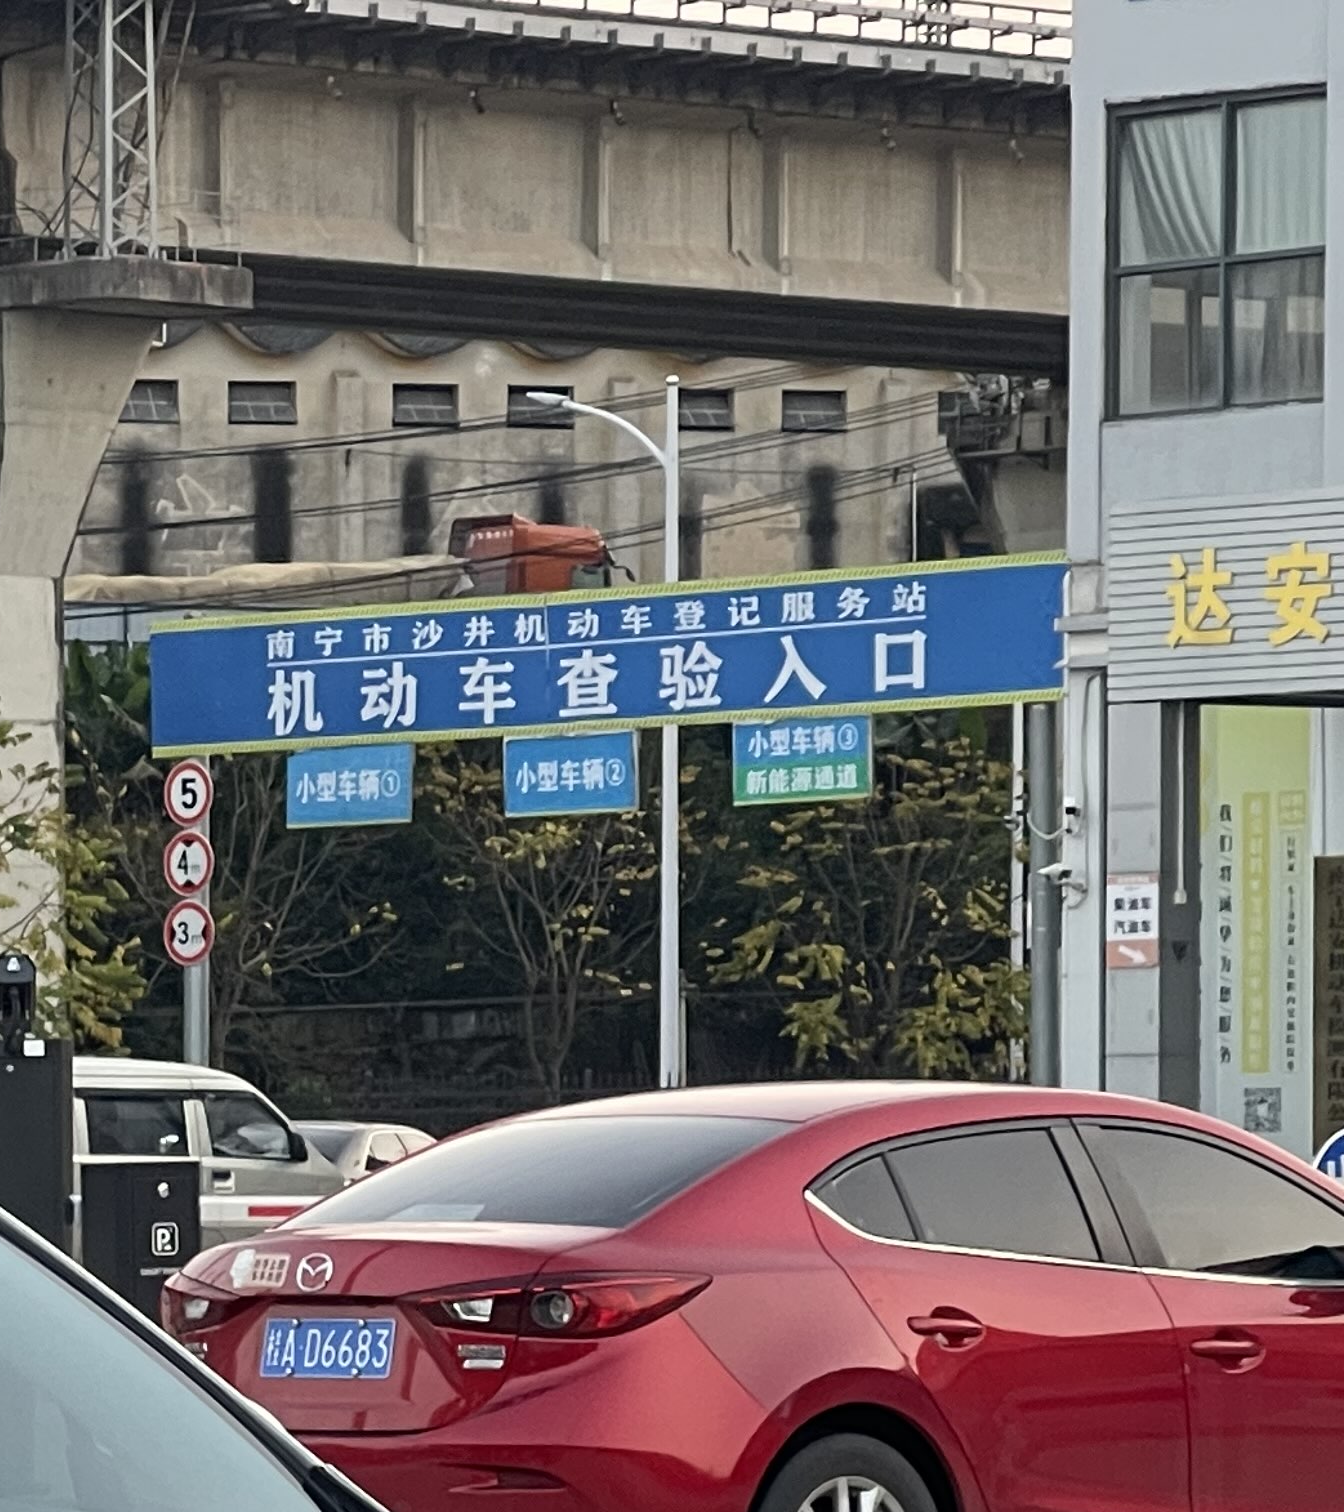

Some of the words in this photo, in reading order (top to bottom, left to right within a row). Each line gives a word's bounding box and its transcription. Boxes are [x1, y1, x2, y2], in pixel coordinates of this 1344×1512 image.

[265, 581, 927, 660] 南宁市沙井机动车登记服务站
[1164, 540, 1333, 648] 达安
[266, 629, 928, 736] 机动车查验入口
[181, 778, 198, 809] 5
[745, 762, 859, 796] 新能源通道
